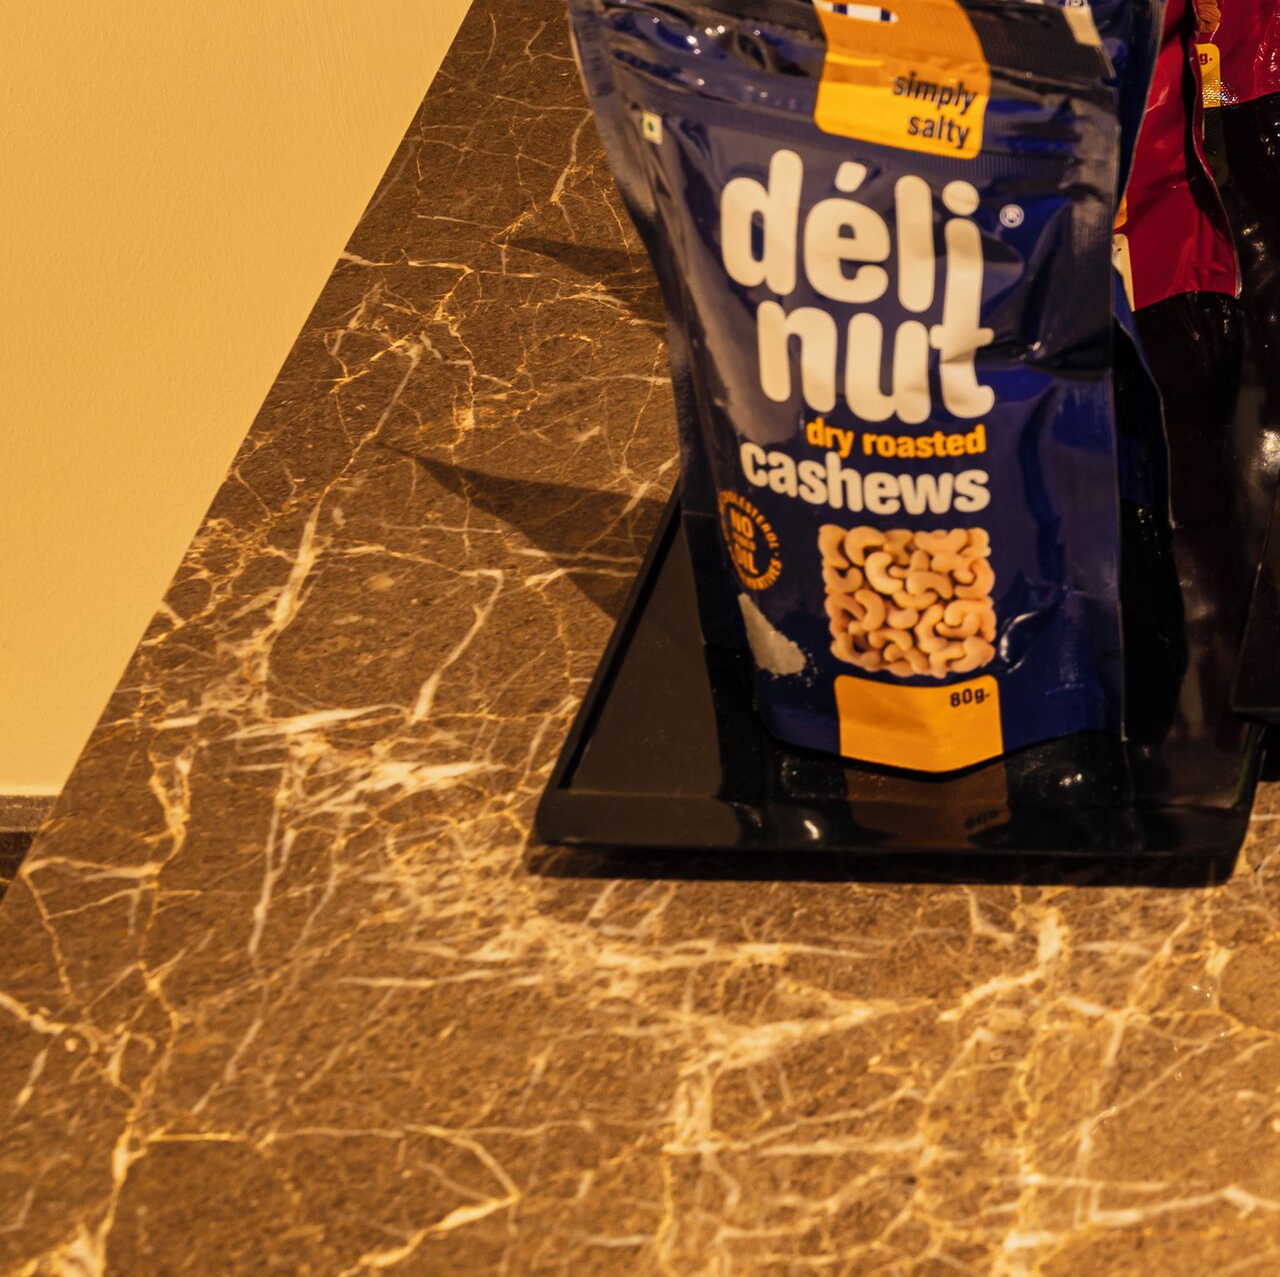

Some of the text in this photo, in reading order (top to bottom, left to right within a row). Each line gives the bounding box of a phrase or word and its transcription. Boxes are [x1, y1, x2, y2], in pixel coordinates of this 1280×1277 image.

[891, 71, 978, 116] simply
[906, 111, 971, 150] salty
[719, 148, 983, 316] déli
[756, 298, 995, 424] nut
[805, 417, 987, 459] dry roasted
[739, 441, 991, 515] cashews
